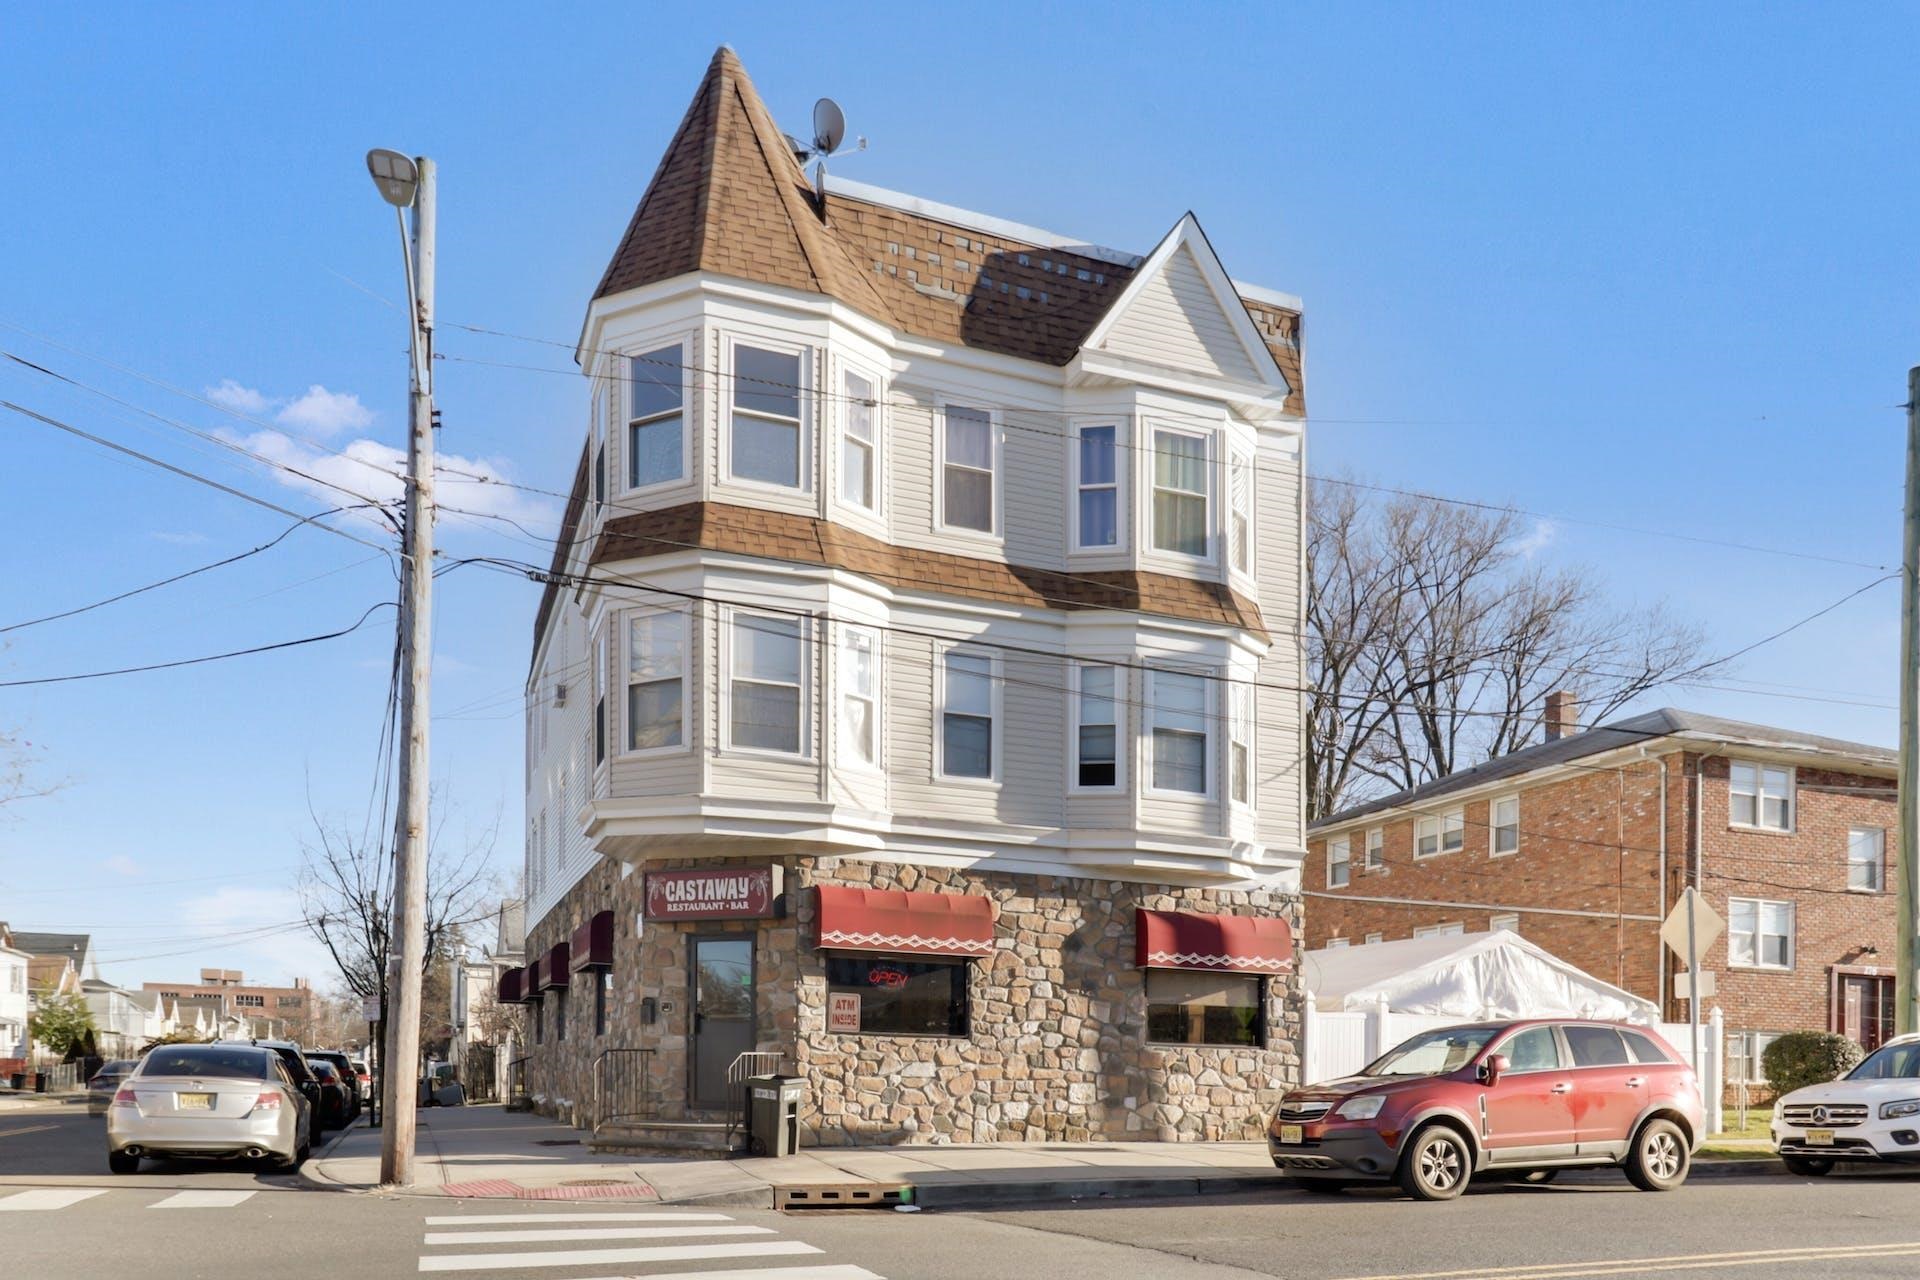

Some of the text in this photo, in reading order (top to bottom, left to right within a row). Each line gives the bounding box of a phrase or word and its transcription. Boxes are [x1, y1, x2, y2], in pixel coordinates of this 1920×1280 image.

[666, 878, 749, 901] CASTAWAY
[667, 901, 749, 912] RESTAURANT BAR
[868, 968, 910, 987] OPEN
[835, 999, 855, 1011] ATM
[832, 1014, 857, 1026] INSIDE
